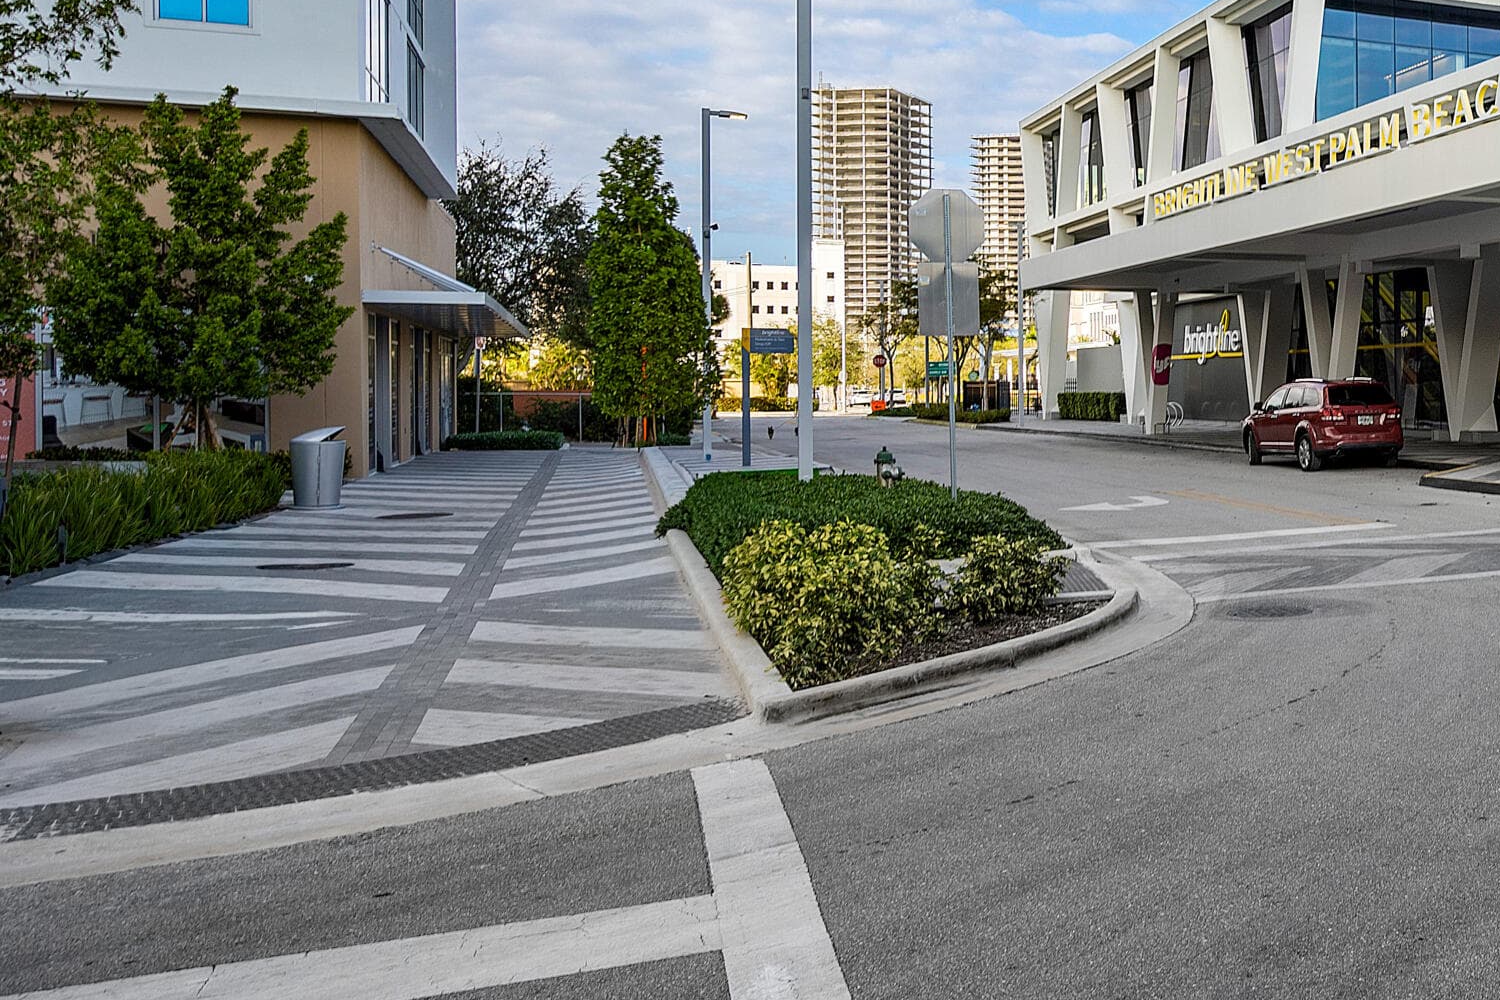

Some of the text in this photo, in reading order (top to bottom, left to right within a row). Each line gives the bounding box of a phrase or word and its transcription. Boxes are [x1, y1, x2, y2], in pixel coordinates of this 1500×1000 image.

[1153, 161, 1258, 219] BRIGHTLINE
[1263, 138, 1325, 186] WEST
[1329, 112, 1400, 166] PALM
[1183, 308, 1240, 365] brightline
